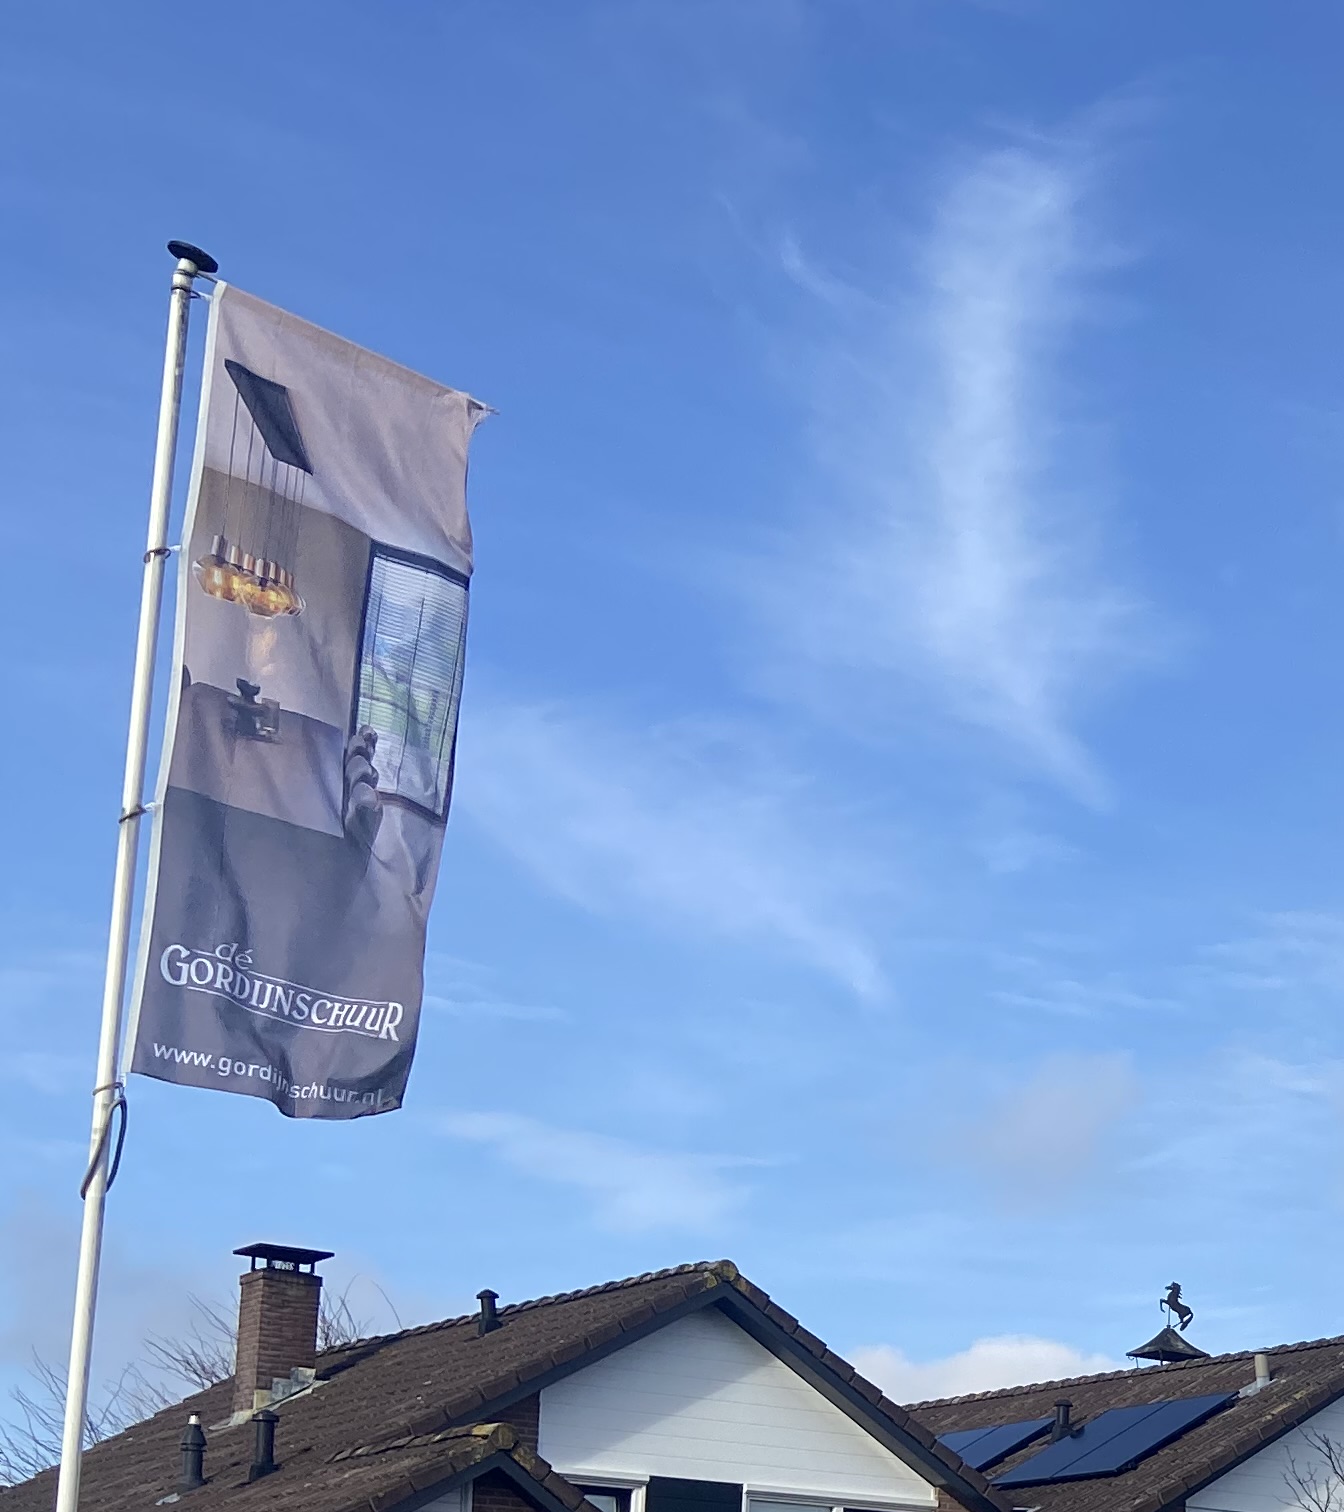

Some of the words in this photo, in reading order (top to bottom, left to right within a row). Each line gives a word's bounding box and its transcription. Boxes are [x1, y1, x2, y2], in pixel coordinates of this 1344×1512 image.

[215, 942, 253, 970] dé
[160, 944, 404, 1042] GORDIJNSCHUUR
[153, 1042, 383, 1107] www.gordijnschuur.nl
